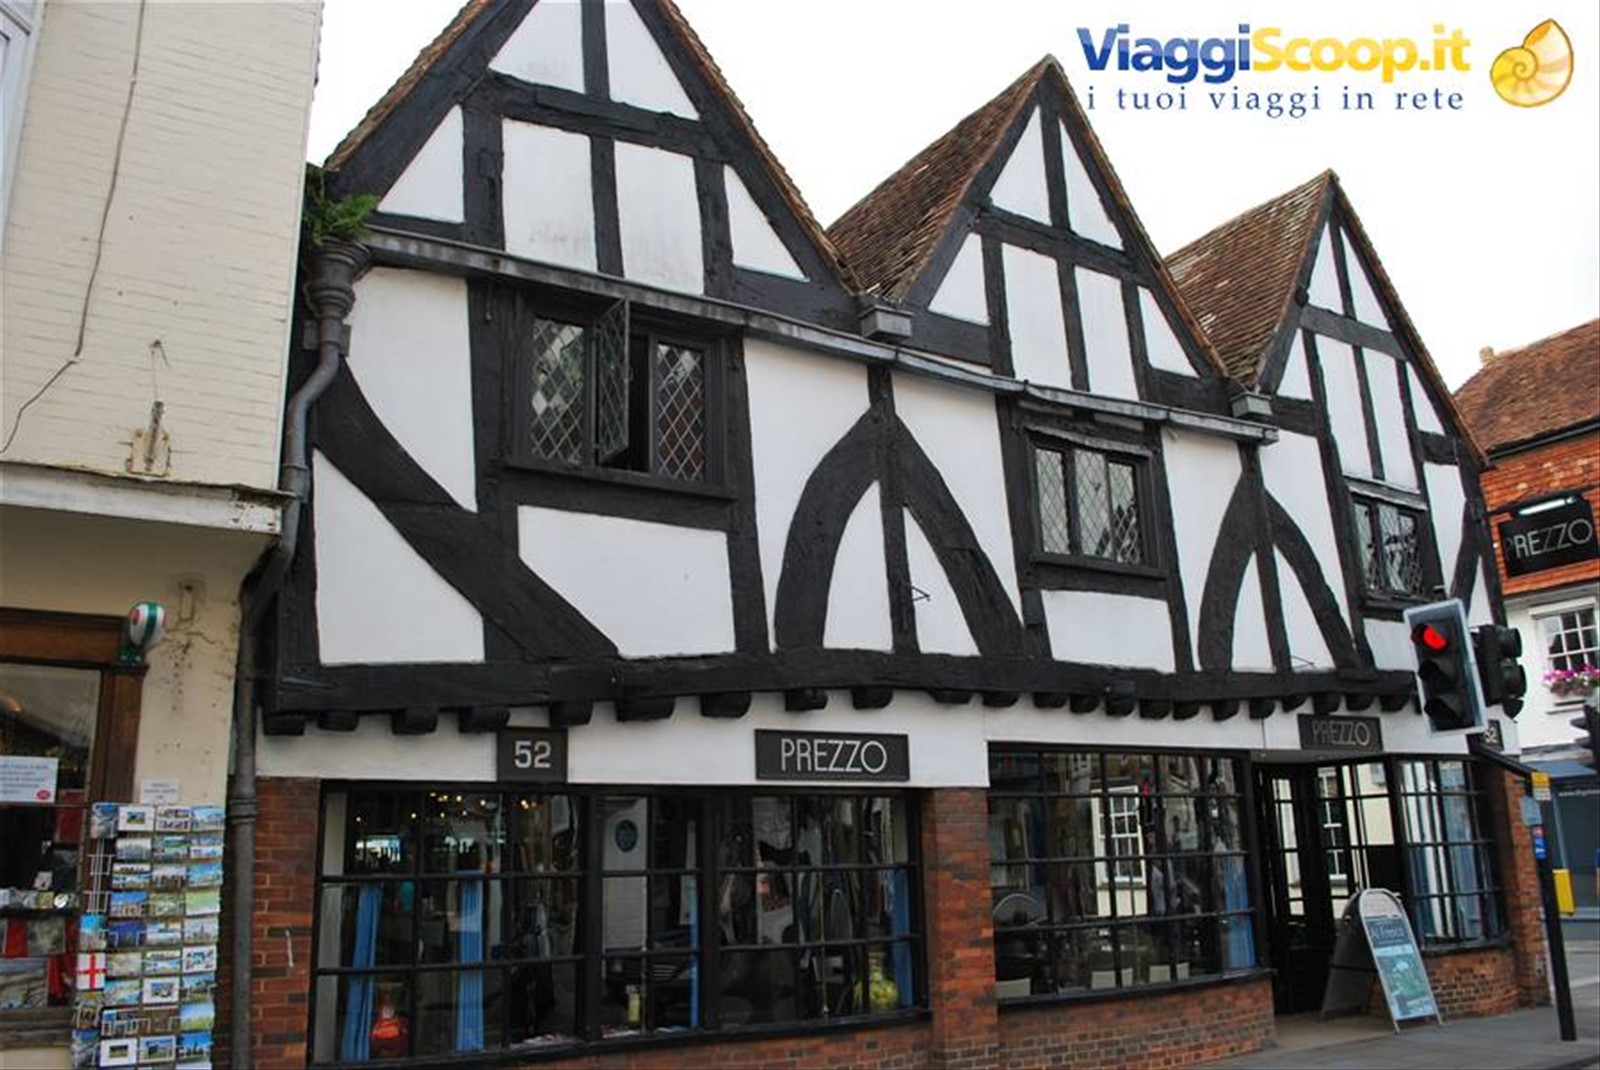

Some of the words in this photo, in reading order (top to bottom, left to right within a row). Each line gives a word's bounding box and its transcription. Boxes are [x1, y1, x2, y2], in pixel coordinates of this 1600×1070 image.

[1312, 720, 1370, 746] PREZZO
[513, 740, 552, 769] 52
[780, 738, 888, 773] PREZZO
